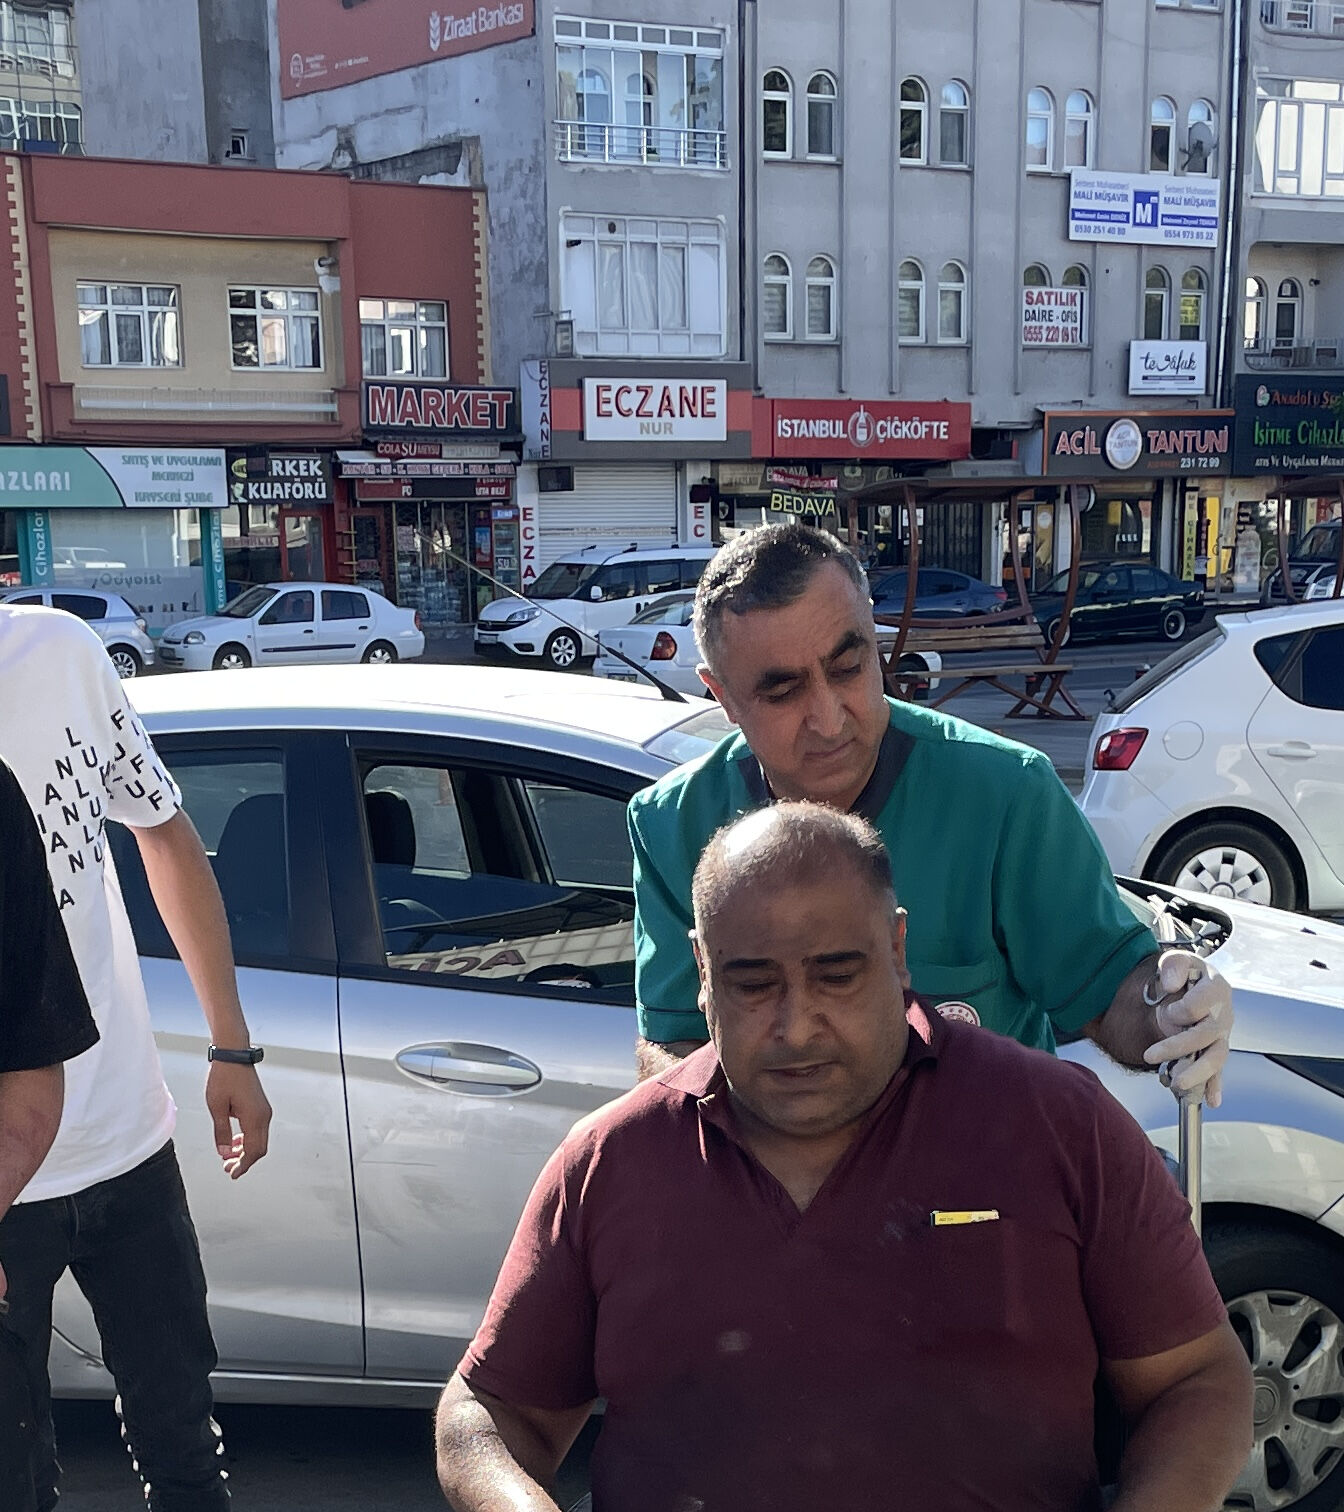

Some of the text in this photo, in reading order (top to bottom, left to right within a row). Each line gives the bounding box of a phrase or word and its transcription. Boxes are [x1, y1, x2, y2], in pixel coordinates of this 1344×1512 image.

[443, 3, 525, 41] Ziraat Bankası
[1135, 202, 1152, 224] M
[1025, 290, 1077, 307] SATILIK
[1024, 306, 1053, 323] DAİRE
[1061, 307, 1078, 324] OFİS
[368, 385, 513, 430] MARKET
[539, 360, 550, 459] ECZANE
[595, 384, 717, 418] ECZANE
[639, 421, 674, 435] NUR
[777, 413, 949, 443] İSTANBUL ÇİĞKÖFTE
[377, 443, 401, 455] COLA
[401, 442, 417, 457] SU
[1056, 425, 1102, 455] ACİL
[1147, 425, 1229, 455] TANTUNİ
[268, 460, 324, 477] RKEK
[1181, 457, 1196, 469] 231
[1197, 457, 1207, 468] 72
[248, 478, 327, 499] KUAFÖRÜ
[771, 493, 835, 516] BEDAVA
